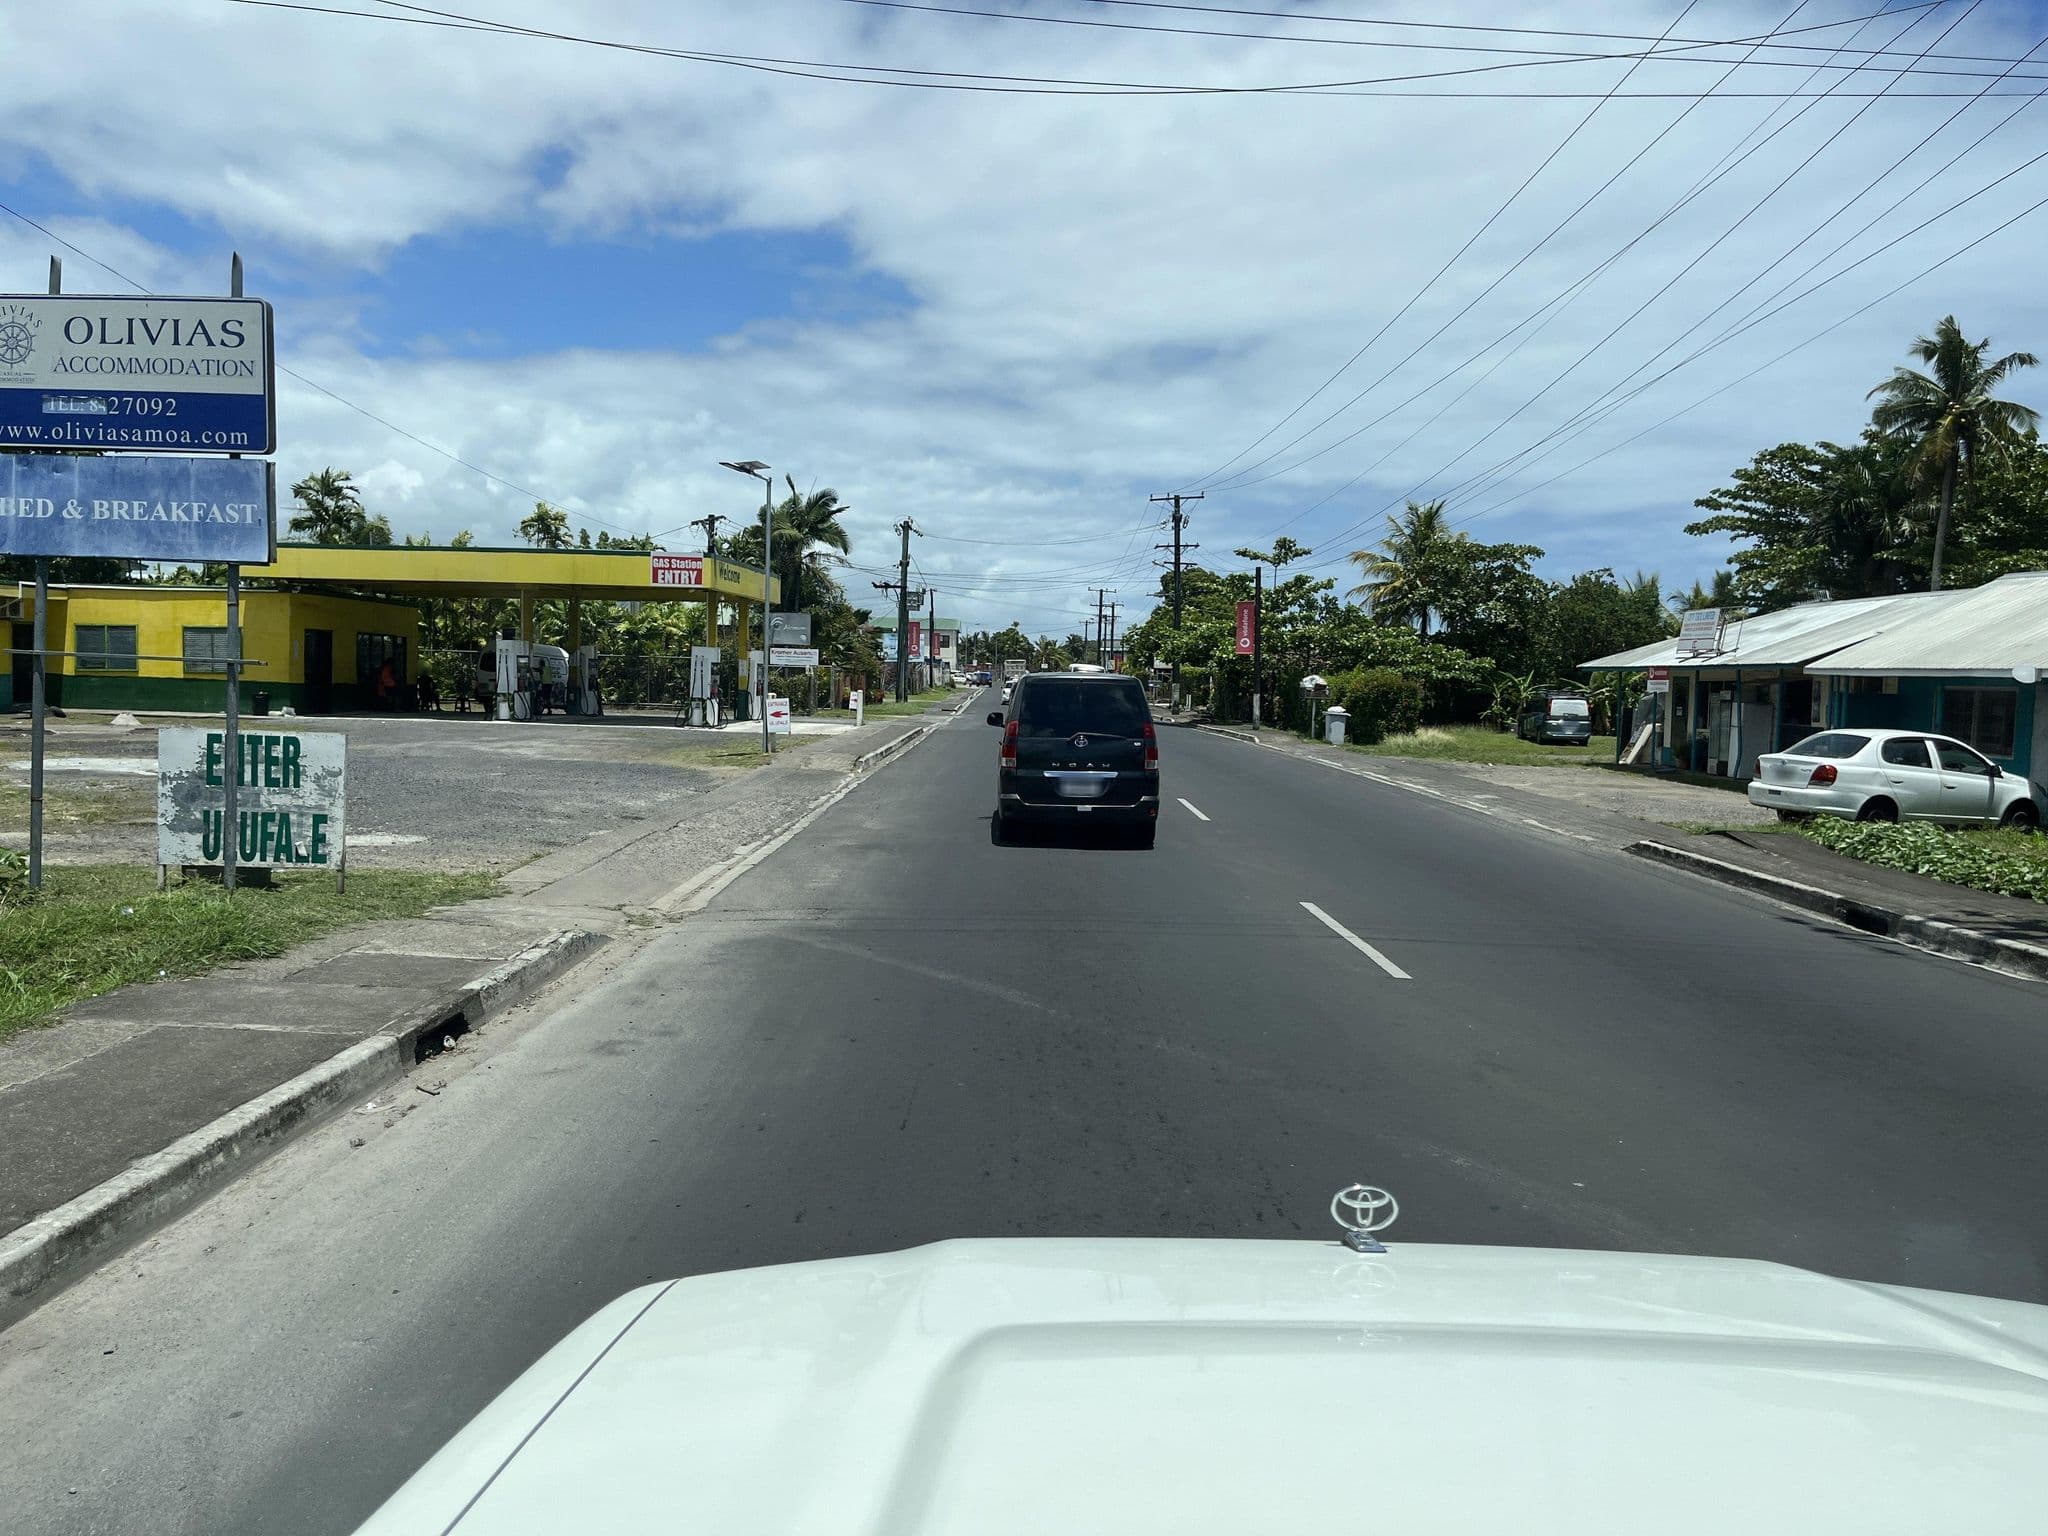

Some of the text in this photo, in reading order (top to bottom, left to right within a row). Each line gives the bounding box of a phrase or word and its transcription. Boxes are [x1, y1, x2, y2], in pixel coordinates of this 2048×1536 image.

[0, 304, 43, 328] IVIAS
[63, 316, 246, 348] OLIVIAS
[53, 356, 255, 377] ACCOMMODATION
[0, 497, 258, 525] BED & BREAKFAST
[653, 558, 703, 569] GAS Station
[658, 569, 697, 585] ENTRY
[202, 810, 328, 864] UUFAE
